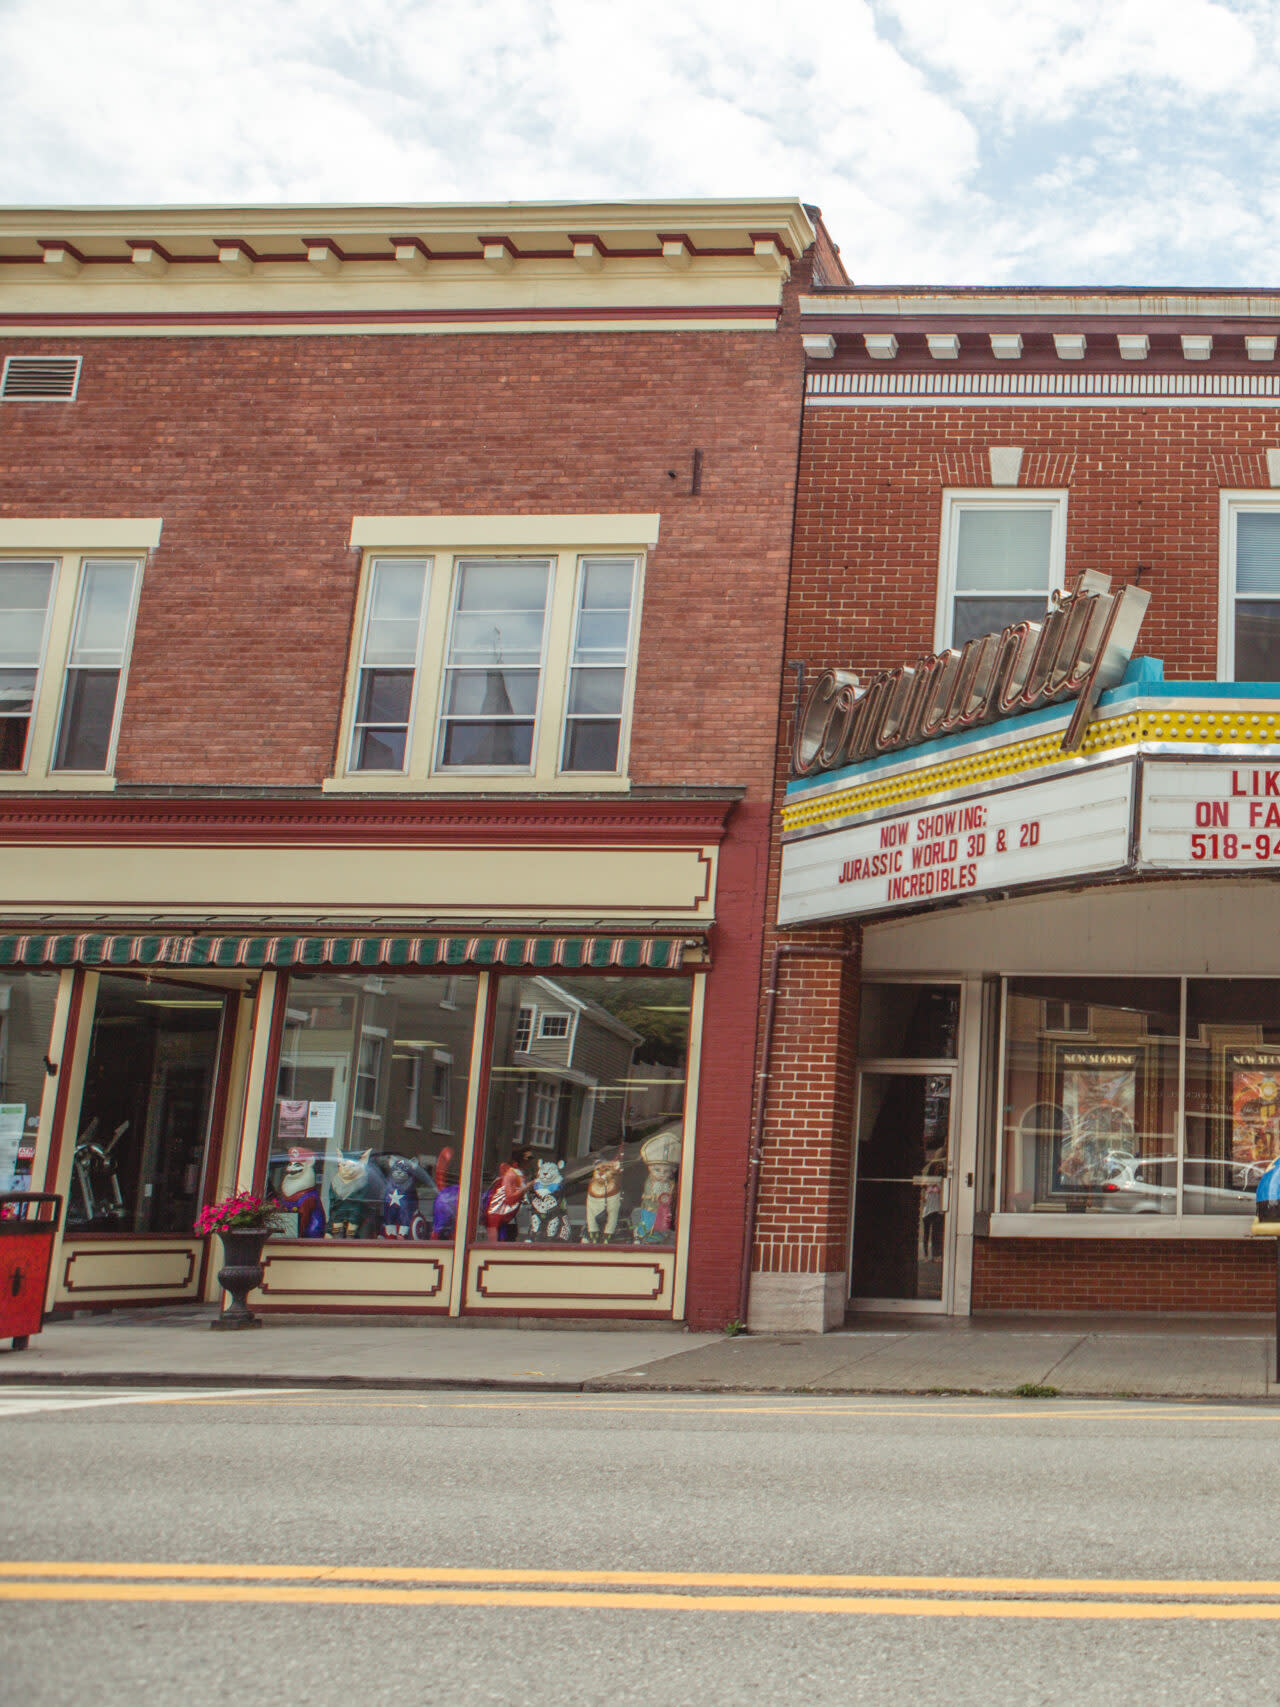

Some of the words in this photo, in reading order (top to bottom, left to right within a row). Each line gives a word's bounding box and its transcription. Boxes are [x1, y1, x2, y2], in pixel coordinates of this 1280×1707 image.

[792, 568, 1152, 776] Community
[879, 821, 910, 849] NOW
[916, 804, 989, 841] SHOWING:
[1195, 801, 1229, 828] ON
[838, 850, 903, 884] JURASSIC
[912, 838, 958, 868] WORLD
[967, 833, 986, 858] 3D
[996, 828, 1008, 852] &
[1019, 821, 1040, 848] 2D
[887, 863, 977, 901] INCREDIBLES
[1064, 1053, 1086, 1064] NOW
[1089, 1054, 1136, 1065] SHOWING
[1233, 1055, 1255, 1065] NOW
